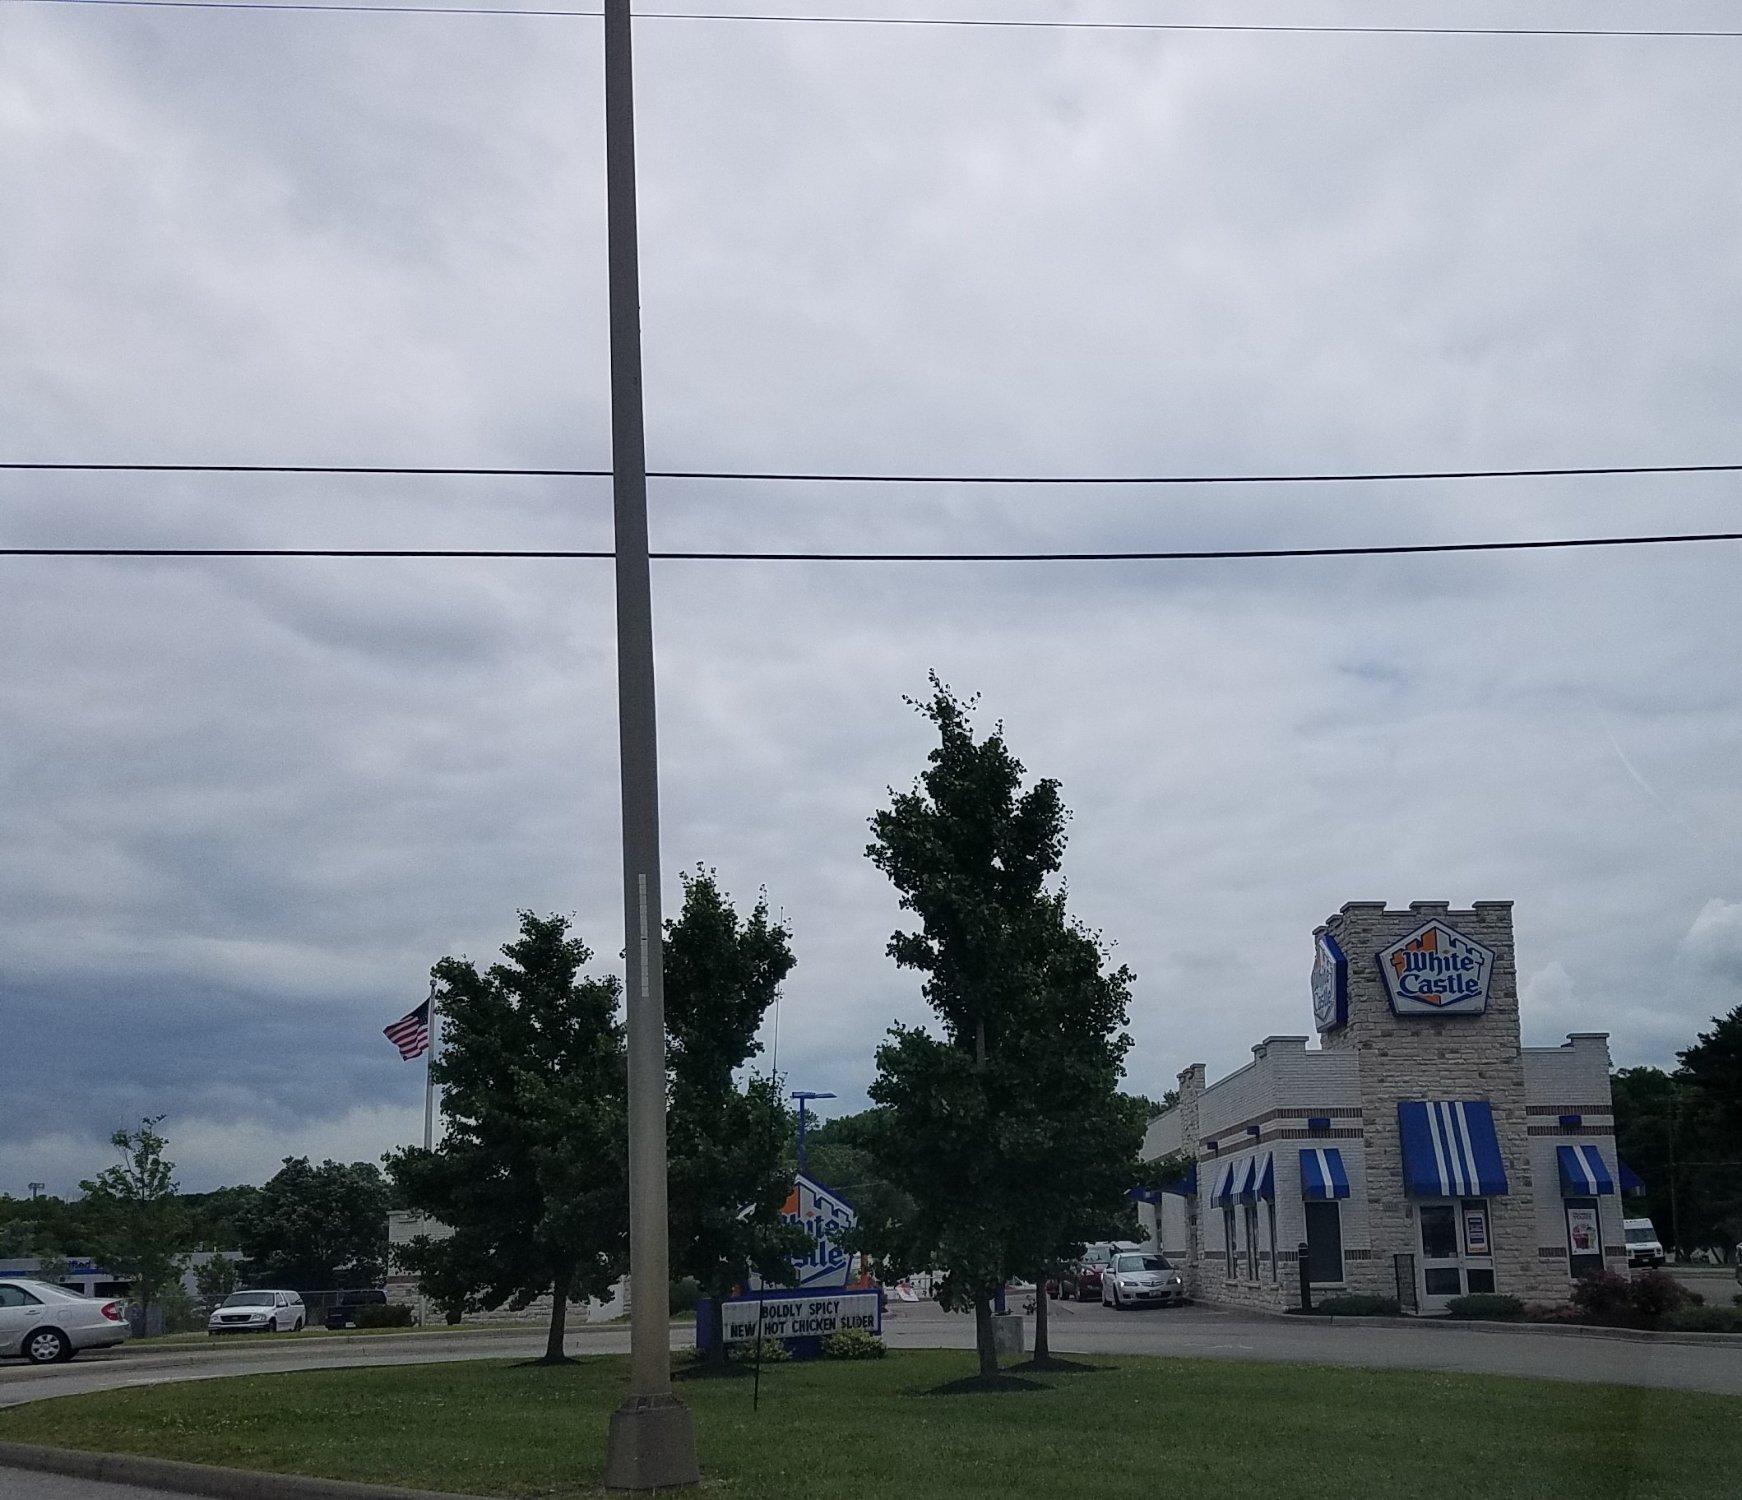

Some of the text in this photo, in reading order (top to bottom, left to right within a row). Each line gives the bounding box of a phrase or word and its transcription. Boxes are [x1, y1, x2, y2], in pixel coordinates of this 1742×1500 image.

[1403, 951, 1474, 976] White
[1400, 974, 1478, 995] Castle
[761, 1301, 840, 1319] BOLDLY SPICY
[730, 1316, 874, 1337] NEW HOT CHICKEN SLIDER
